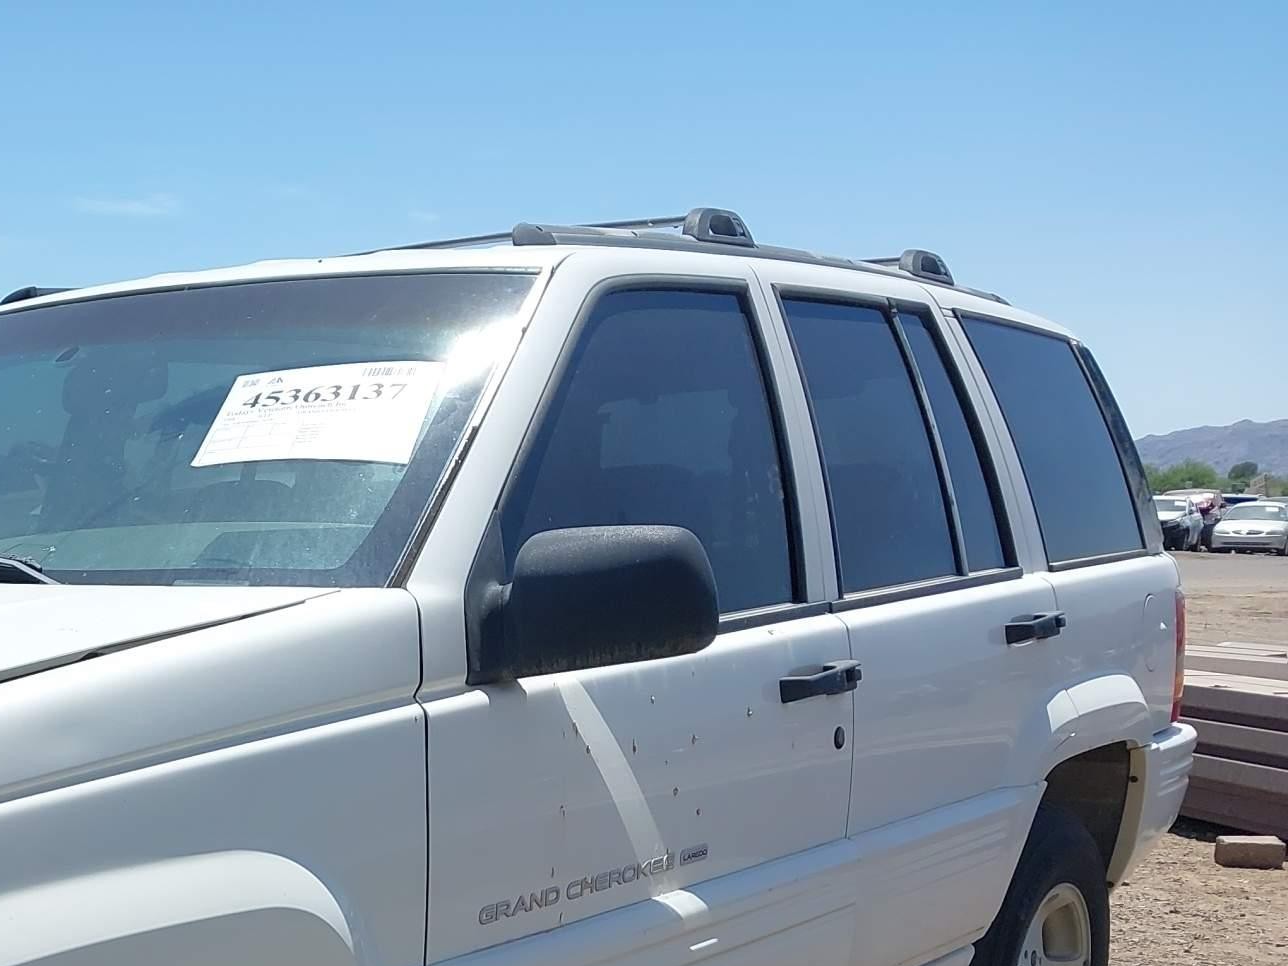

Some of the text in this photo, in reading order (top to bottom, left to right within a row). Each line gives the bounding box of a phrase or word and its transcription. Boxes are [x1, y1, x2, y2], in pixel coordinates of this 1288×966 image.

[242, 383, 409, 409] 45363137
[478, 855, 674, 925] GRAND CHEROKEE
